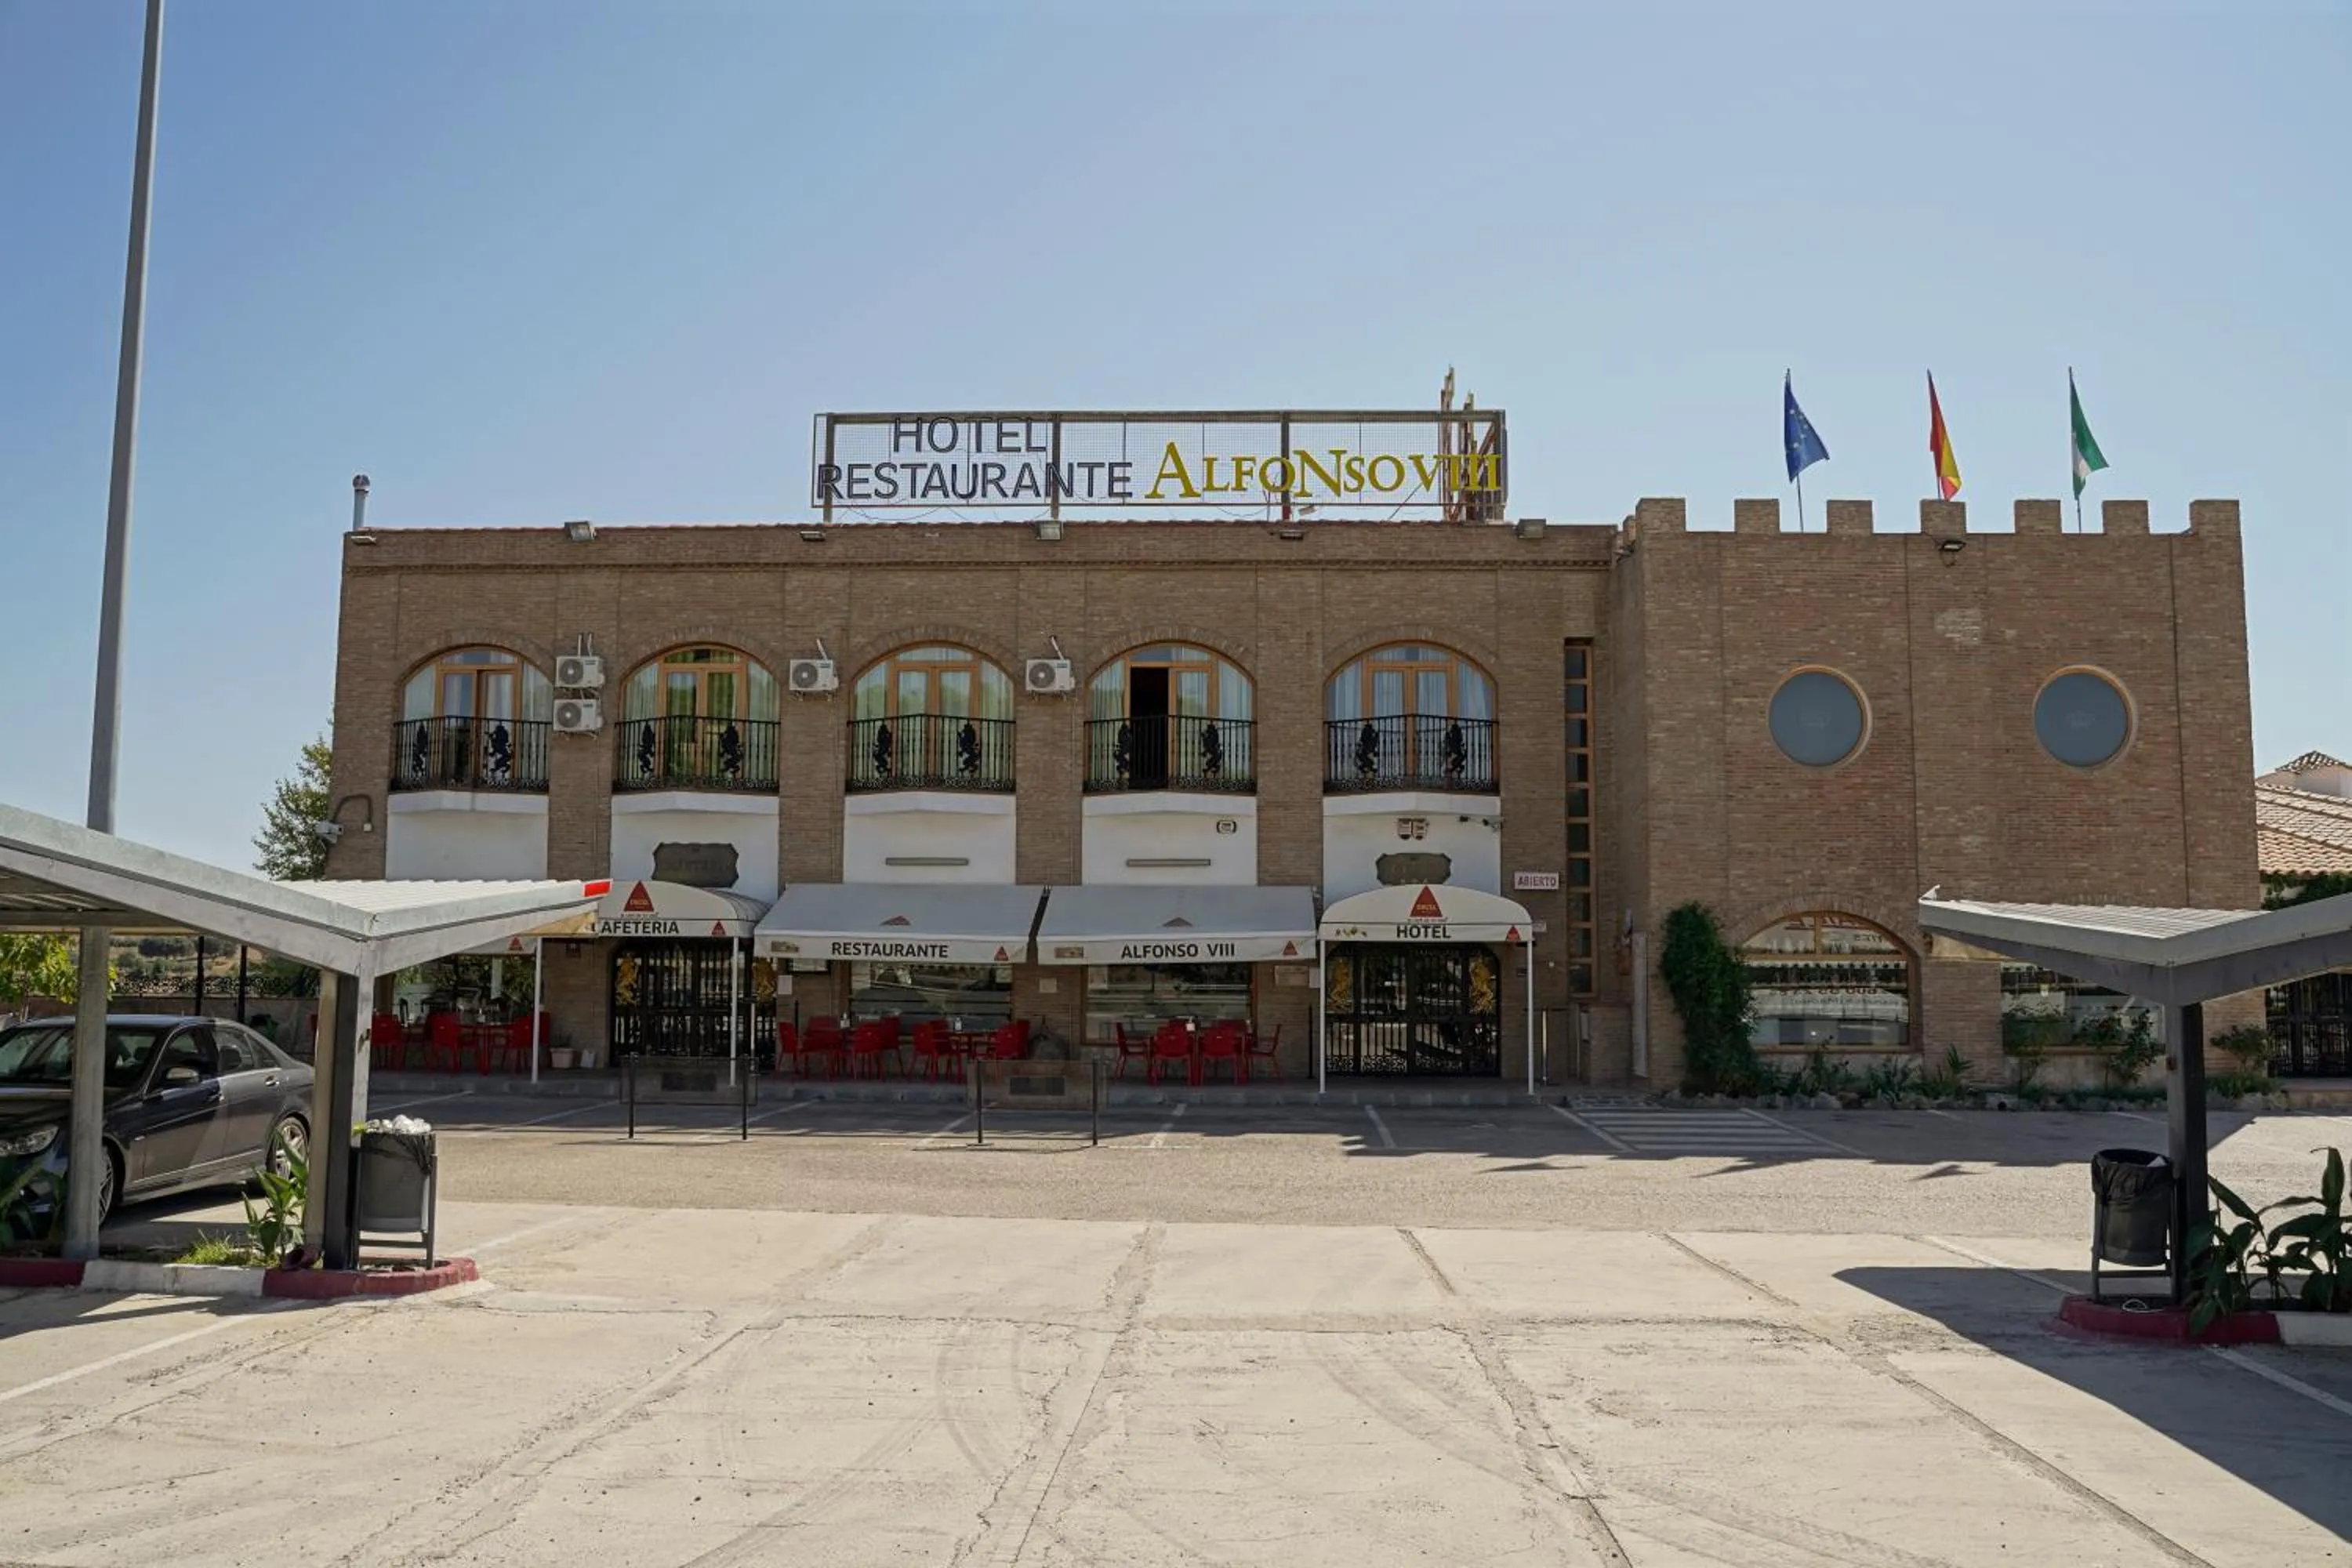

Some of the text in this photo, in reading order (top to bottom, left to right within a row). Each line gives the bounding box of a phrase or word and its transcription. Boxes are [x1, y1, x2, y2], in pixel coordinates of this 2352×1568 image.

[893, 416, 1047, 453] HOTEL
[816, 462, 1133, 500] RESTAURANTE
[1517, 876, 1556, 887] ABIERTO
[1396, 924, 1452, 939] HOTEL
[831, 942, 949, 959] RESTAURANTE
[1120, 942, 1236, 959] ALFONSO VIII
